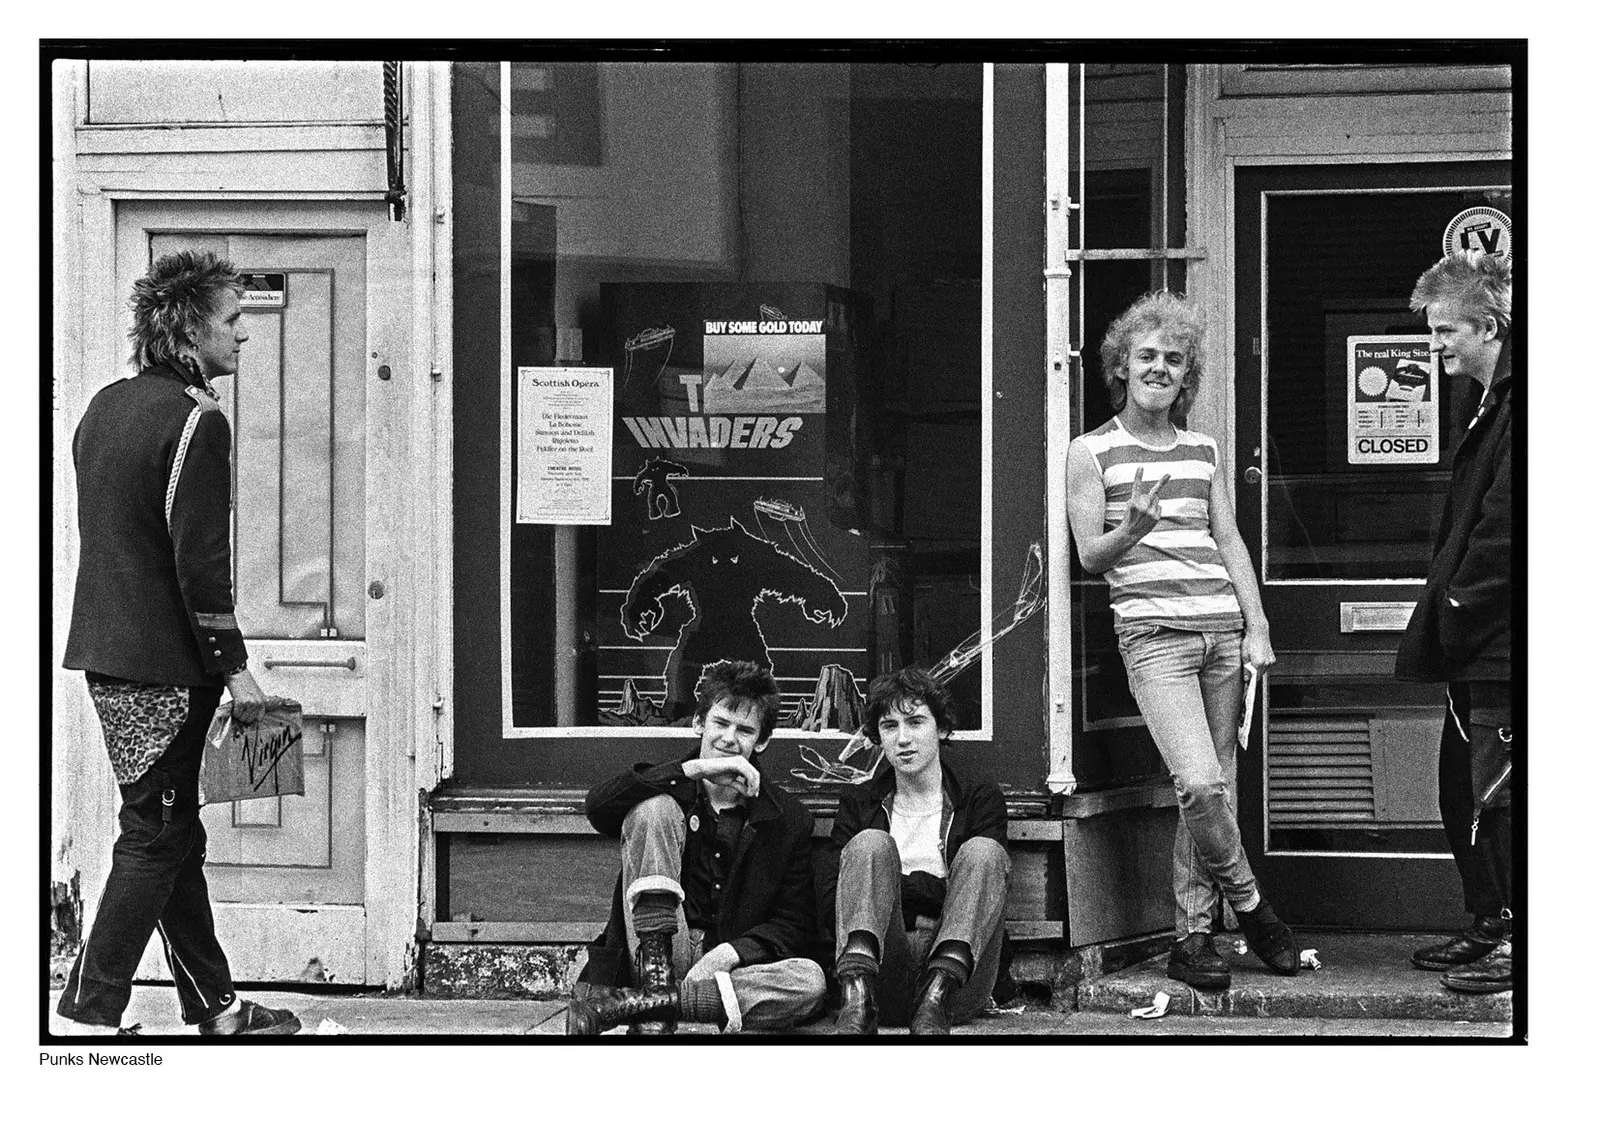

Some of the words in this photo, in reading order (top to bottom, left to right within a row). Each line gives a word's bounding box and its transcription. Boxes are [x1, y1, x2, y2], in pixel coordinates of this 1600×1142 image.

[705, 321, 727, 334] BUY
[728, 321, 758, 334] SOME
[759, 321, 788, 333] GOLD
[789, 320, 823, 333] TODAY
[1356, 349, 1373, 358] The
[1374, 350, 1389, 358] real
[1391, 348, 1411, 358] King
[531, 378, 570, 388] Scottish
[571, 379, 600, 389] Opera
[621, 416, 804, 449] INVADERS
[1358, 438, 1429, 454] CLOSED
